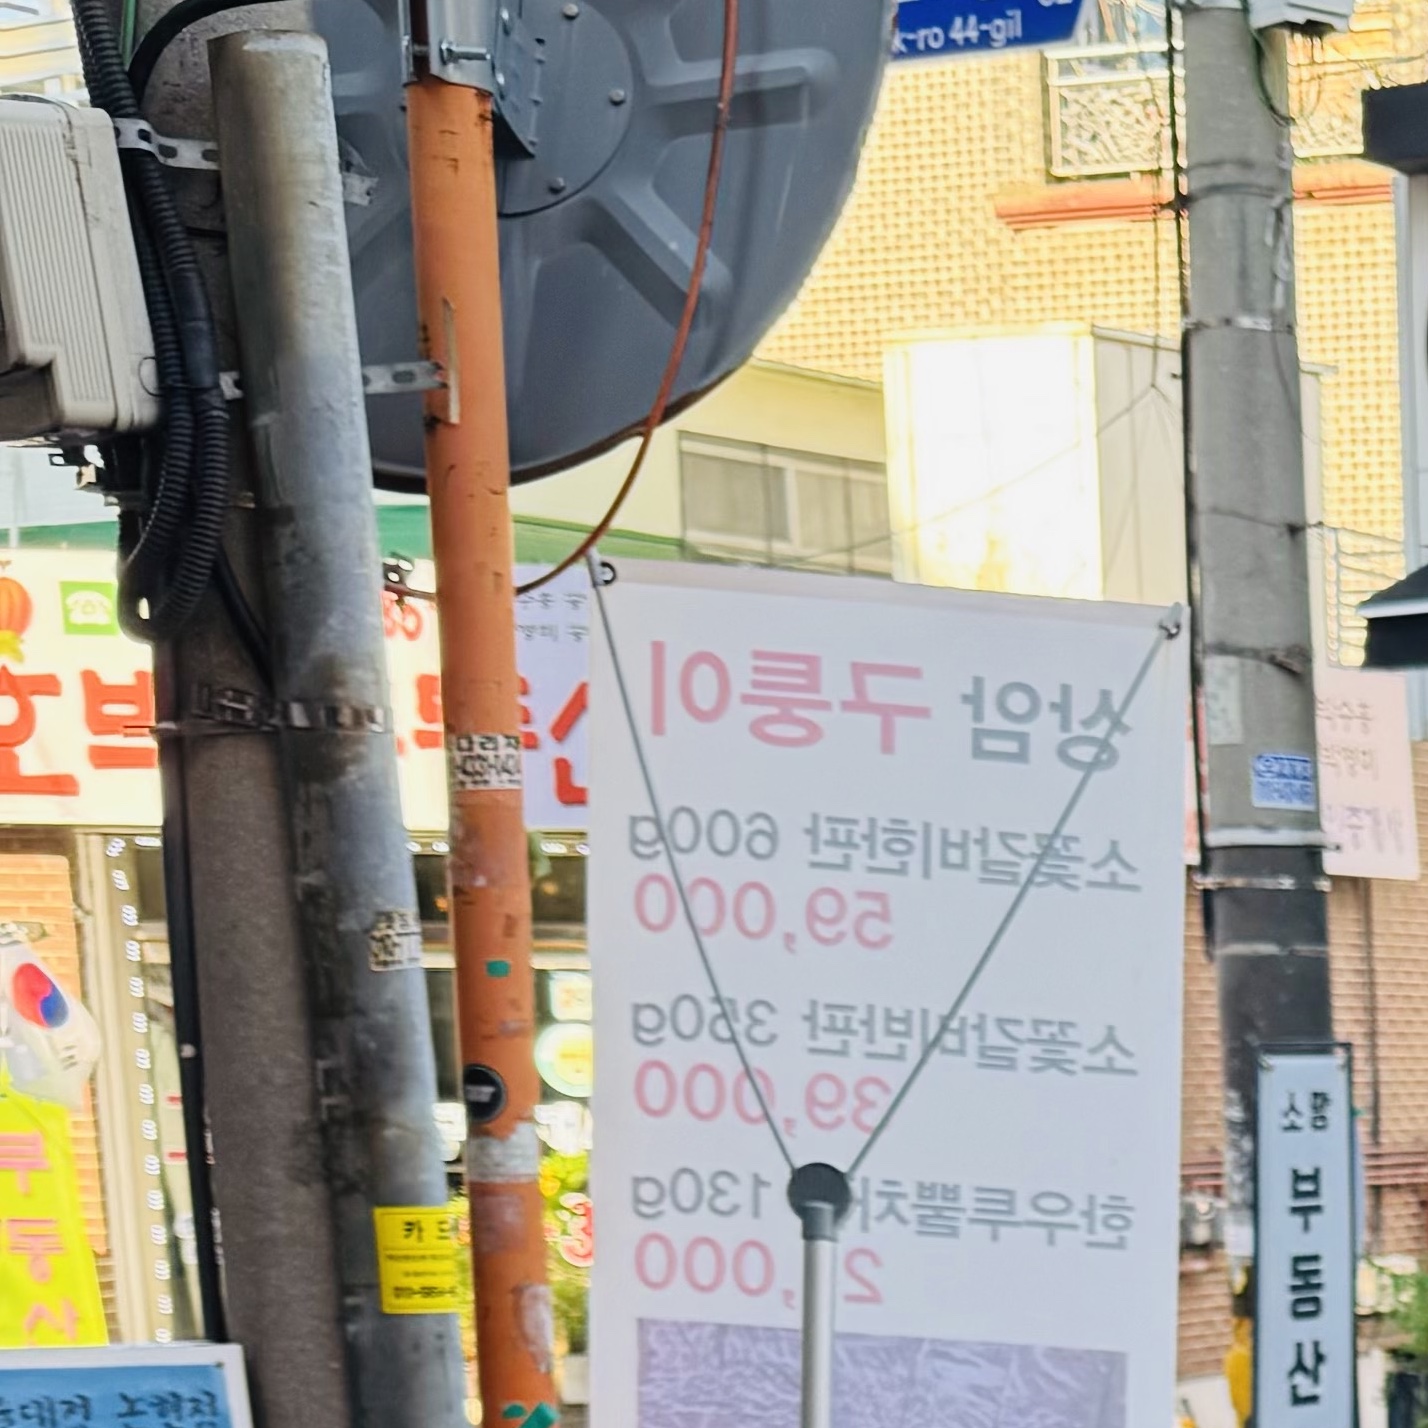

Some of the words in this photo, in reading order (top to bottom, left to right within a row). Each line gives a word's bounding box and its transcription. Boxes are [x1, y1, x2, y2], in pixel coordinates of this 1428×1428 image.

[948, 9, 1022, 48] 44-gil
[1280, 1091, 1331, 1133] 소망
[1287, 1165, 1326, 1408] 부동산
